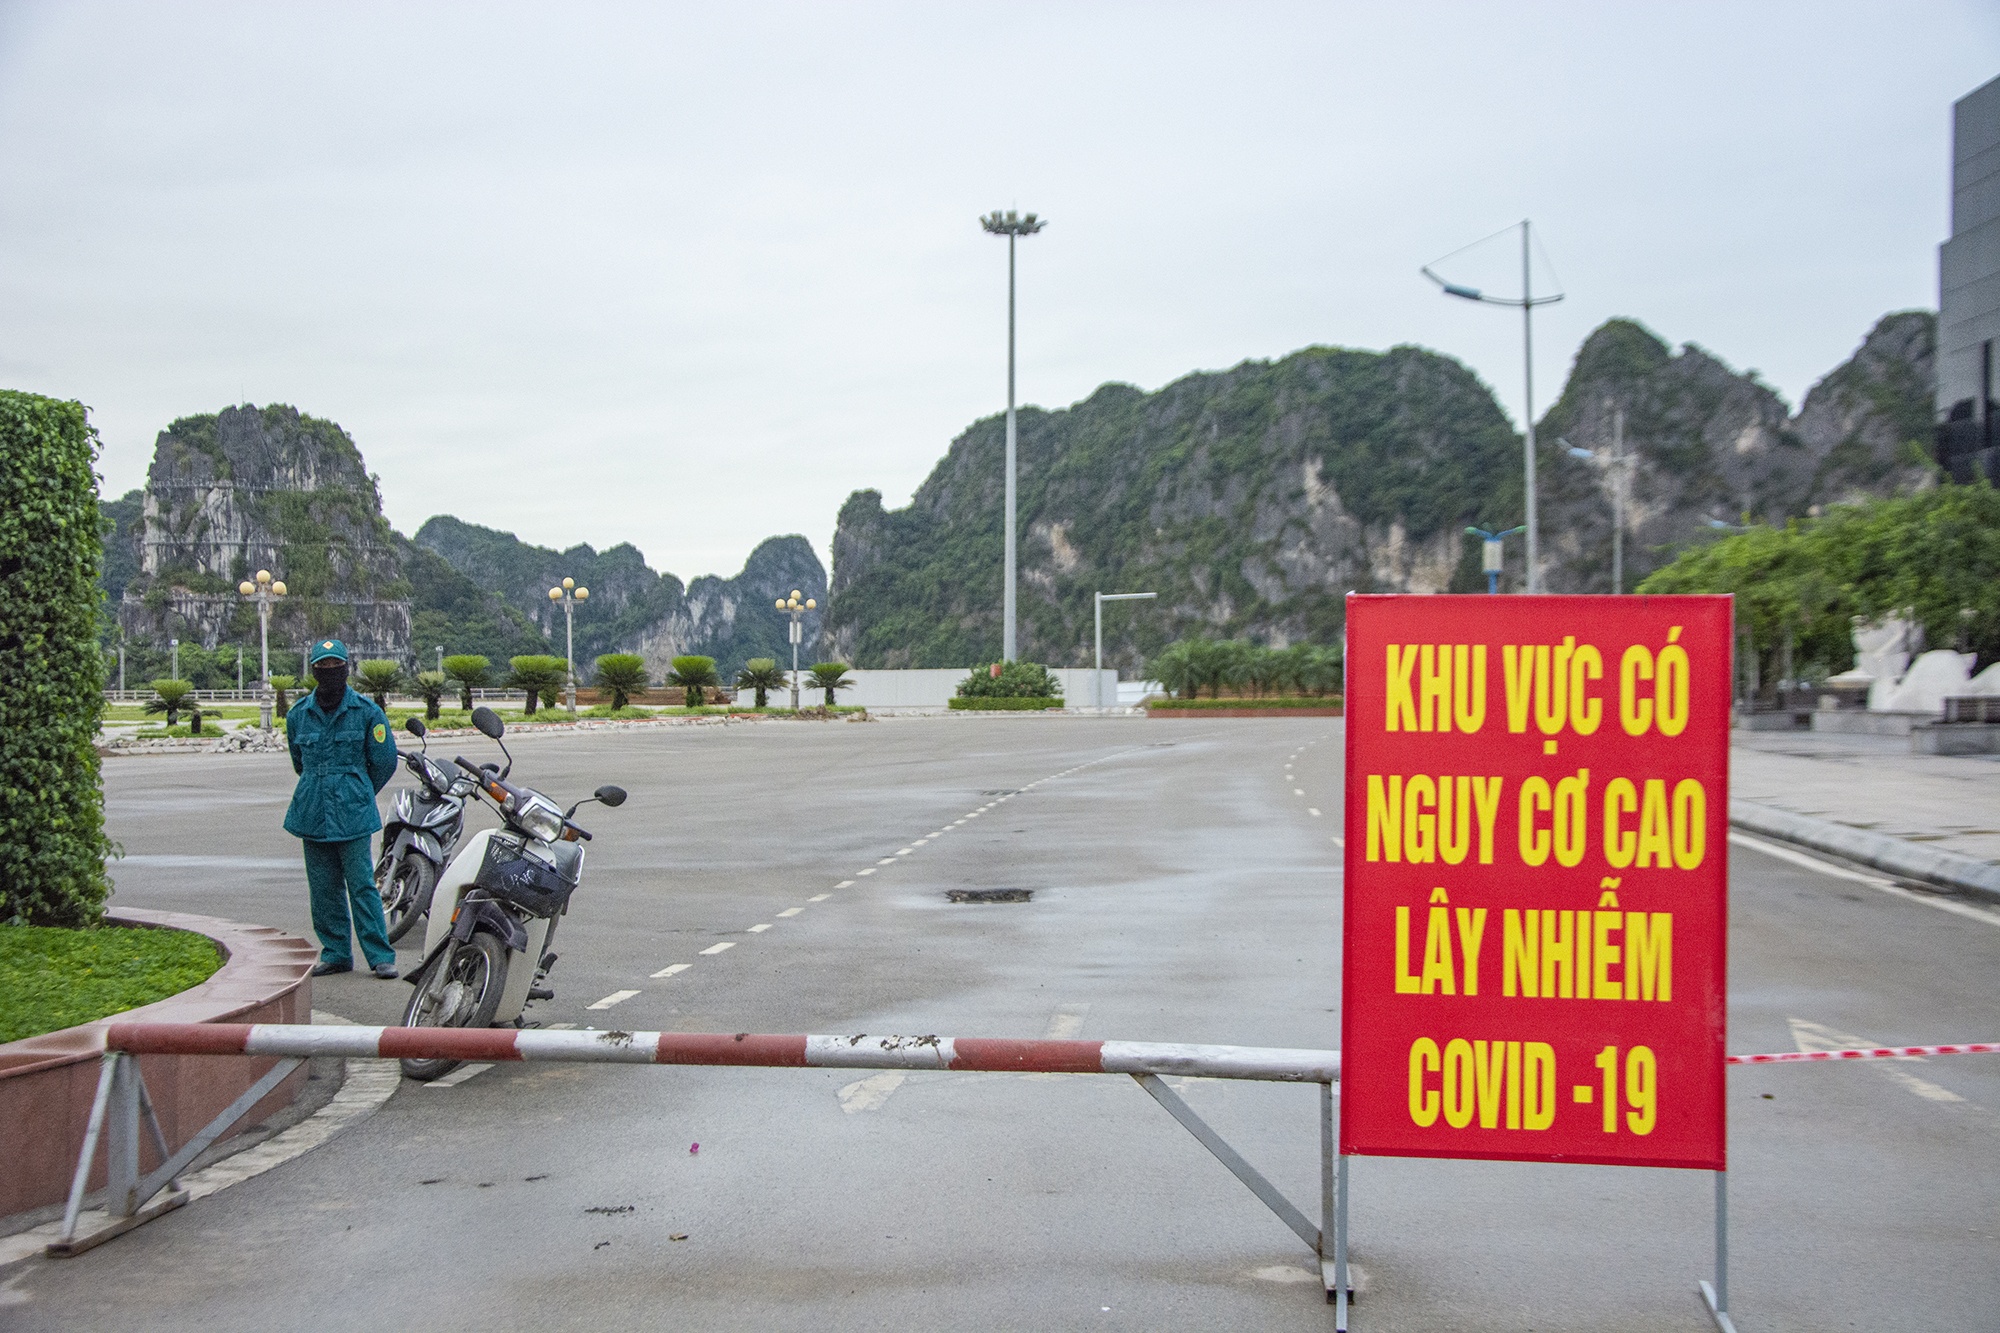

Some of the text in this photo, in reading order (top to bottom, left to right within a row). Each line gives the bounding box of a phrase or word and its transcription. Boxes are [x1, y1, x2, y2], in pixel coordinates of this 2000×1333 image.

[1385, 625, 1690, 755] KHU VỰC CÓ
[1366, 768, 1706, 871] NGUY CƠ CAO
[1395, 876, 1673, 1002] LÂY NHIỄM
[1408, 1036, 1657, 1136] COVID -19
